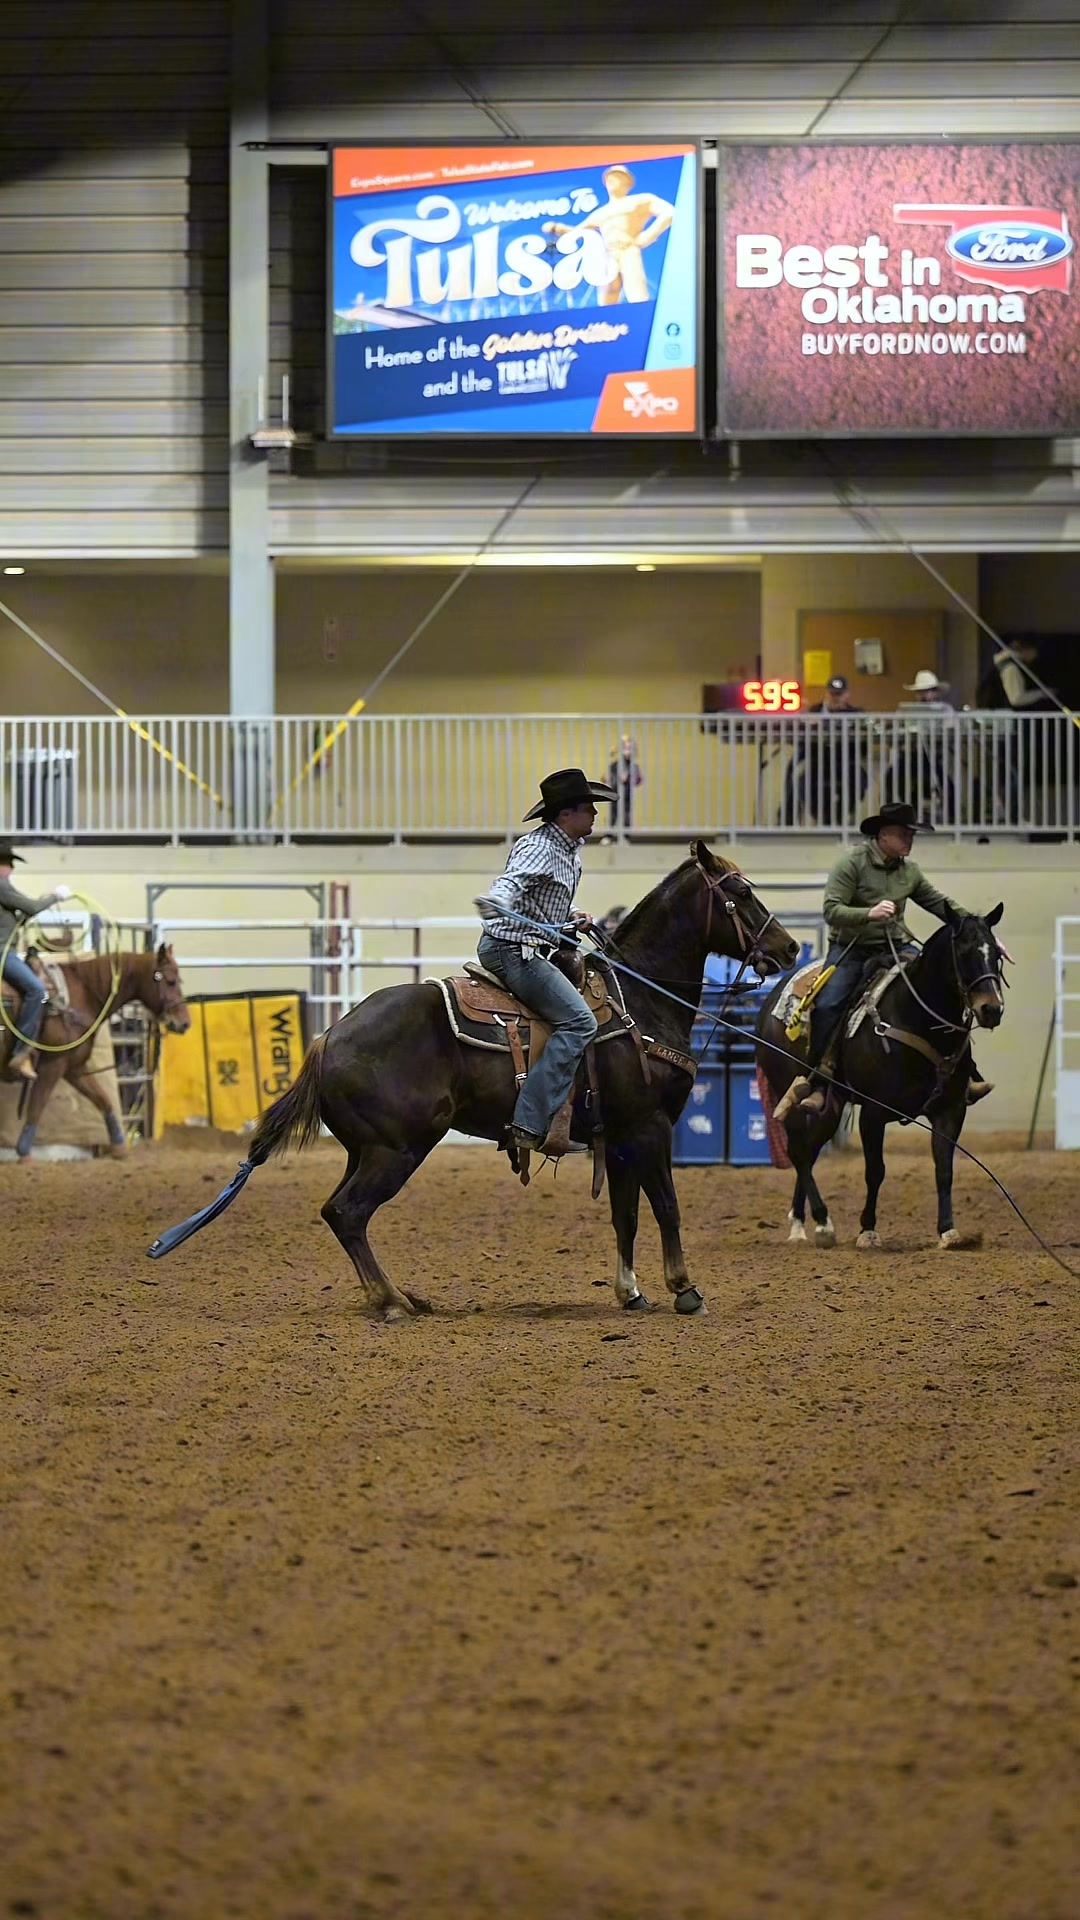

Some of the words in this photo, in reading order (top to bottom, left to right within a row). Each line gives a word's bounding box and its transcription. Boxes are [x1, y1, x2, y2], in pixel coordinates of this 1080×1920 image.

[463, 196, 571, 226] Welcome
[569, 187, 599, 214] To
[350, 195, 620, 309] Tulsa
[736, 234, 889, 288] Best
[901, 249, 941, 286] in
[970, 229, 1049, 262] Ford
[801, 287, 1026, 324] Oklahoma
[365, 344, 423, 369] Home
[426, 336, 449, 362] of
[449, 335, 480, 359] the
[482, 330, 554, 360] Golden
[553, 321, 629, 347] Driller
[801, 333, 1027, 355] BUYFORDNOW.COM
[423, 370, 458, 397] and
[461, 369, 492, 393] the
[496, 358, 548, 381] TULSA
[263, 1005, 294, 1095] Wrang
